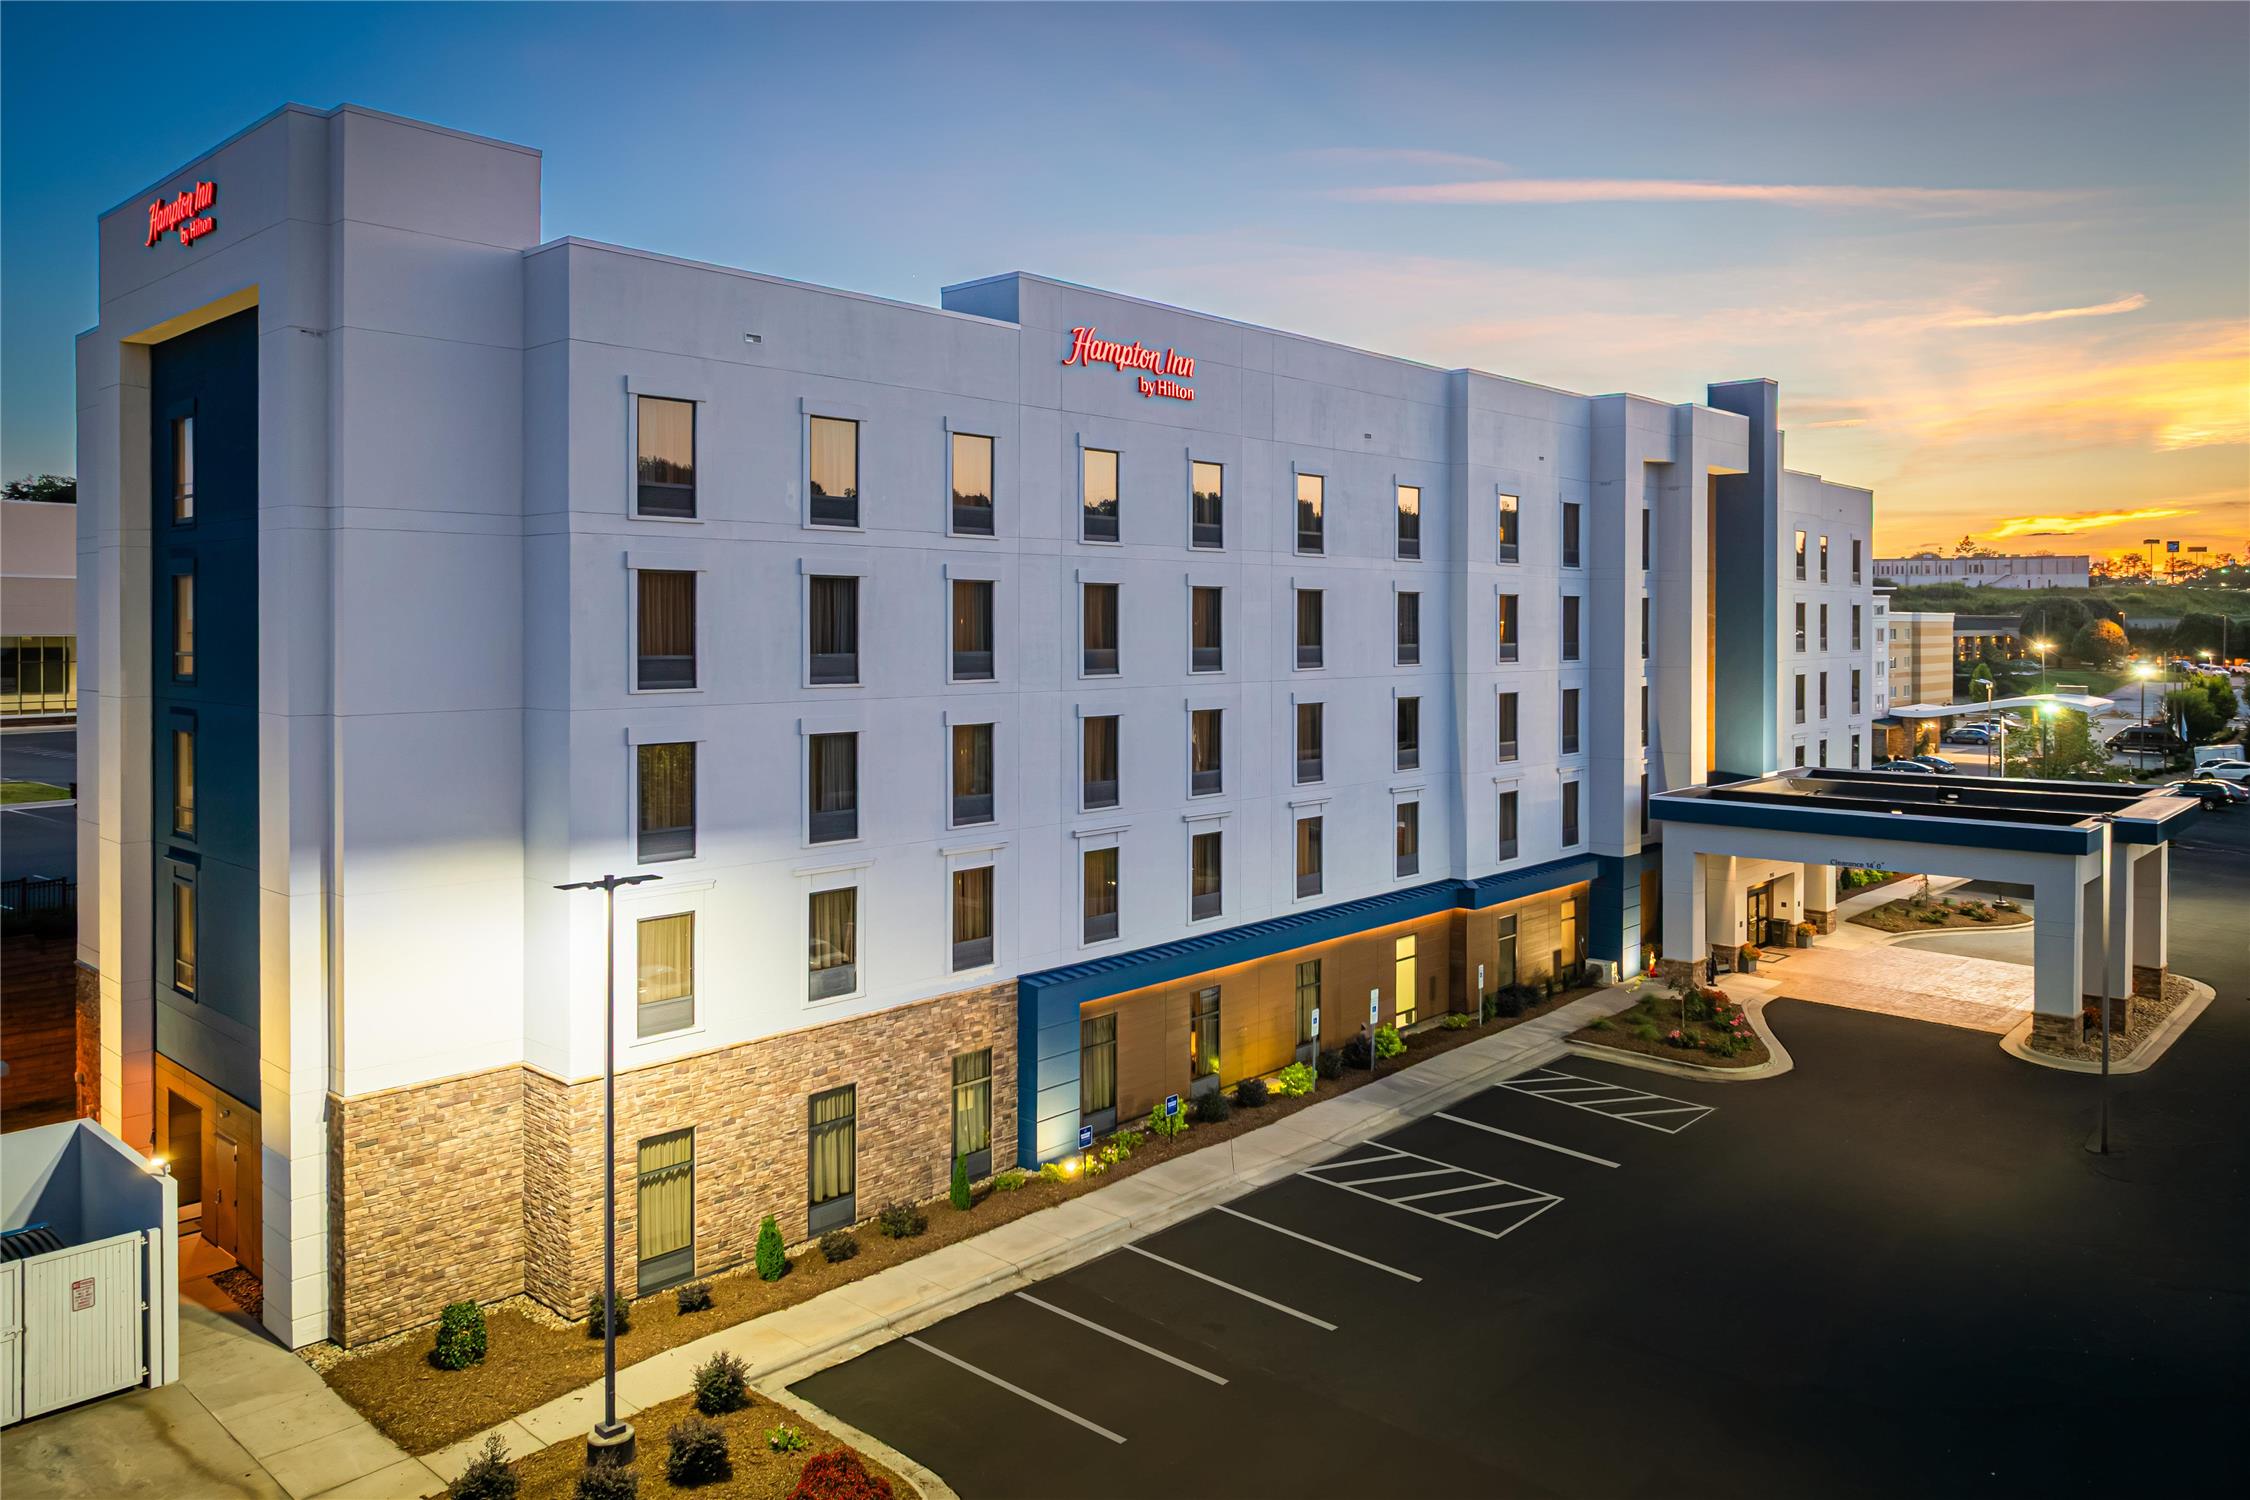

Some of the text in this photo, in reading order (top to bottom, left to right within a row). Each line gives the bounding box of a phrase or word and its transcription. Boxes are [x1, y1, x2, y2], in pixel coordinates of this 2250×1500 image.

[144, 181, 213, 247] Hampton Inn
[180, 217, 213, 246] by Hilton
[1062, 326, 1195, 377] Hampton Inn
[1138, 376, 1195, 401] by Hilton
[1830, 859, 1864, 868] Clearance
